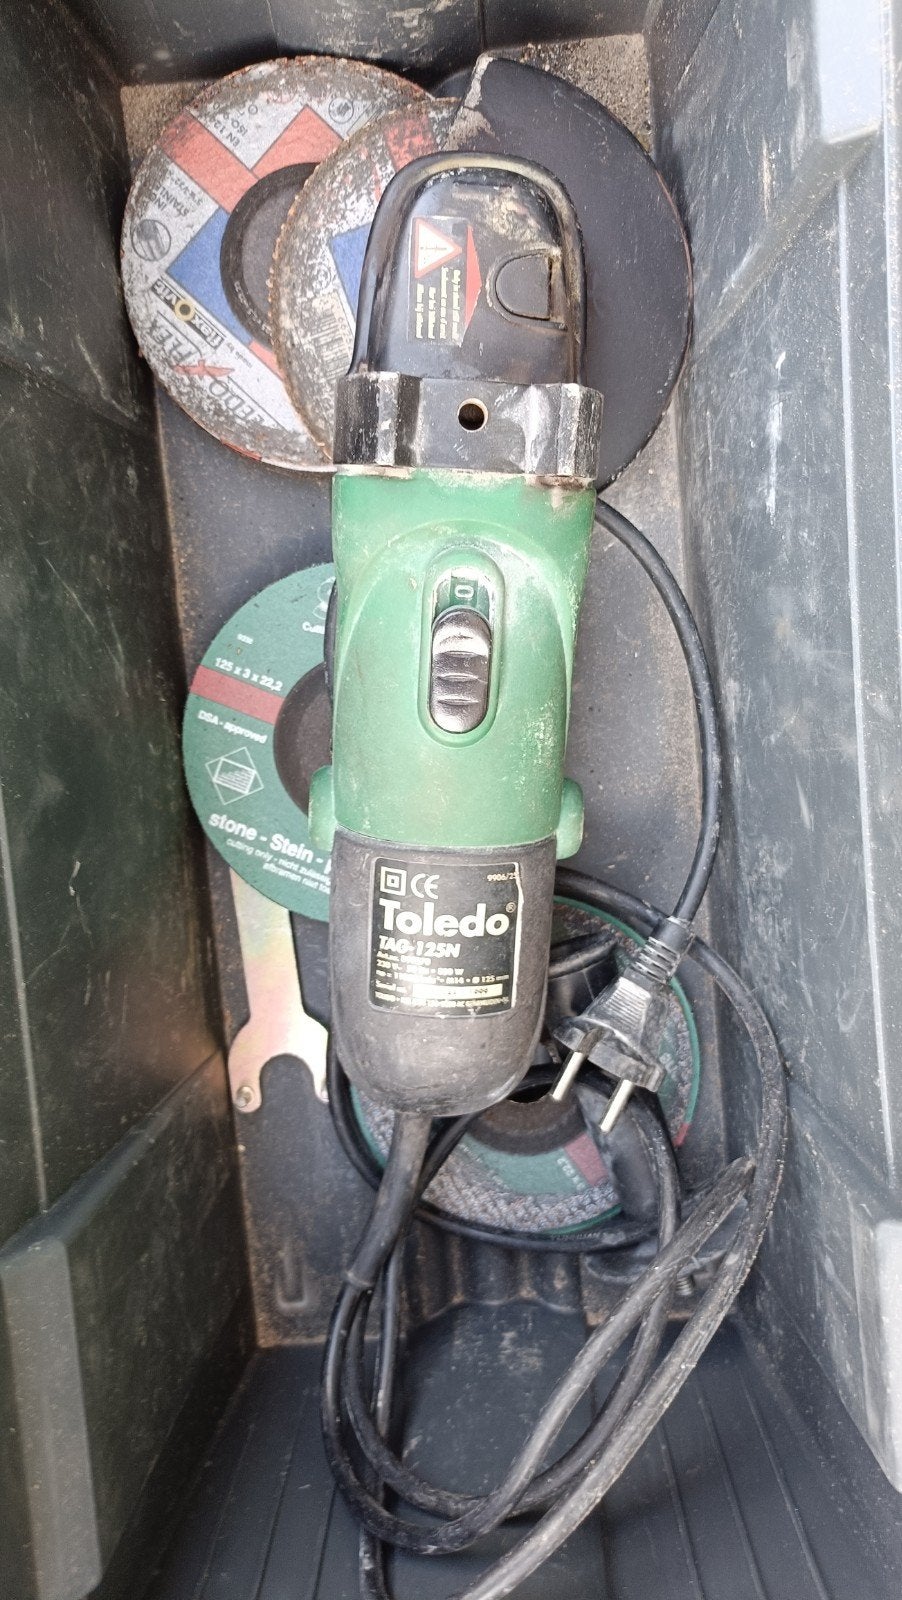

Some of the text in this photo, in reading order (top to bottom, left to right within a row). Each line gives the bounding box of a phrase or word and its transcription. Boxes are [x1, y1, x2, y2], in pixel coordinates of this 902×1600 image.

[215, 658, 283, 691] 125 x 3 x 22,2
[223, 722, 267, 743] approved
[208, 813, 257, 840] stone
[270, 834, 314, 863] Stein
[379, 898, 509, 937] Toledo
